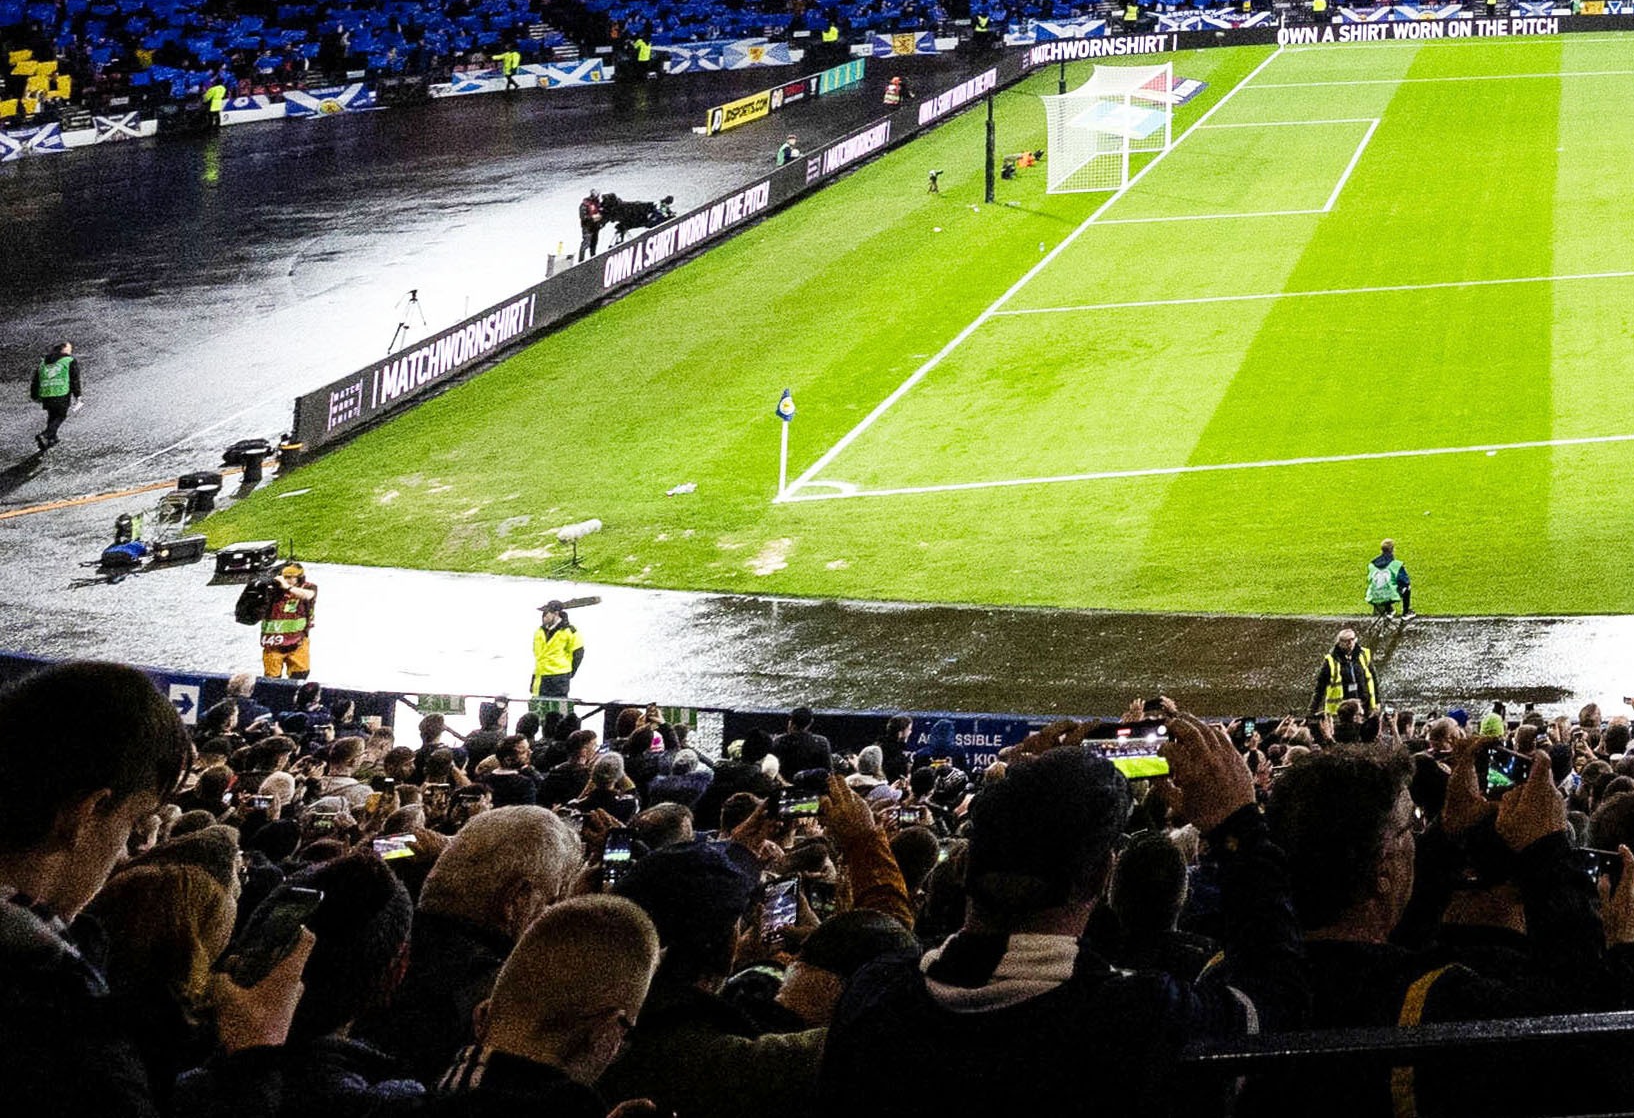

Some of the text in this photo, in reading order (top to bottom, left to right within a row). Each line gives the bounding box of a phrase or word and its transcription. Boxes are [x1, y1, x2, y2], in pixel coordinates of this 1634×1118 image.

[1278, 17, 1559, 45] OWN A SHIRT WORN ON THE PITCH
[604, 180, 770, 288] OWN A SHIRT WORN ON THE PITCH
[381, 296, 529, 404] MATCHWORNSHIRT
